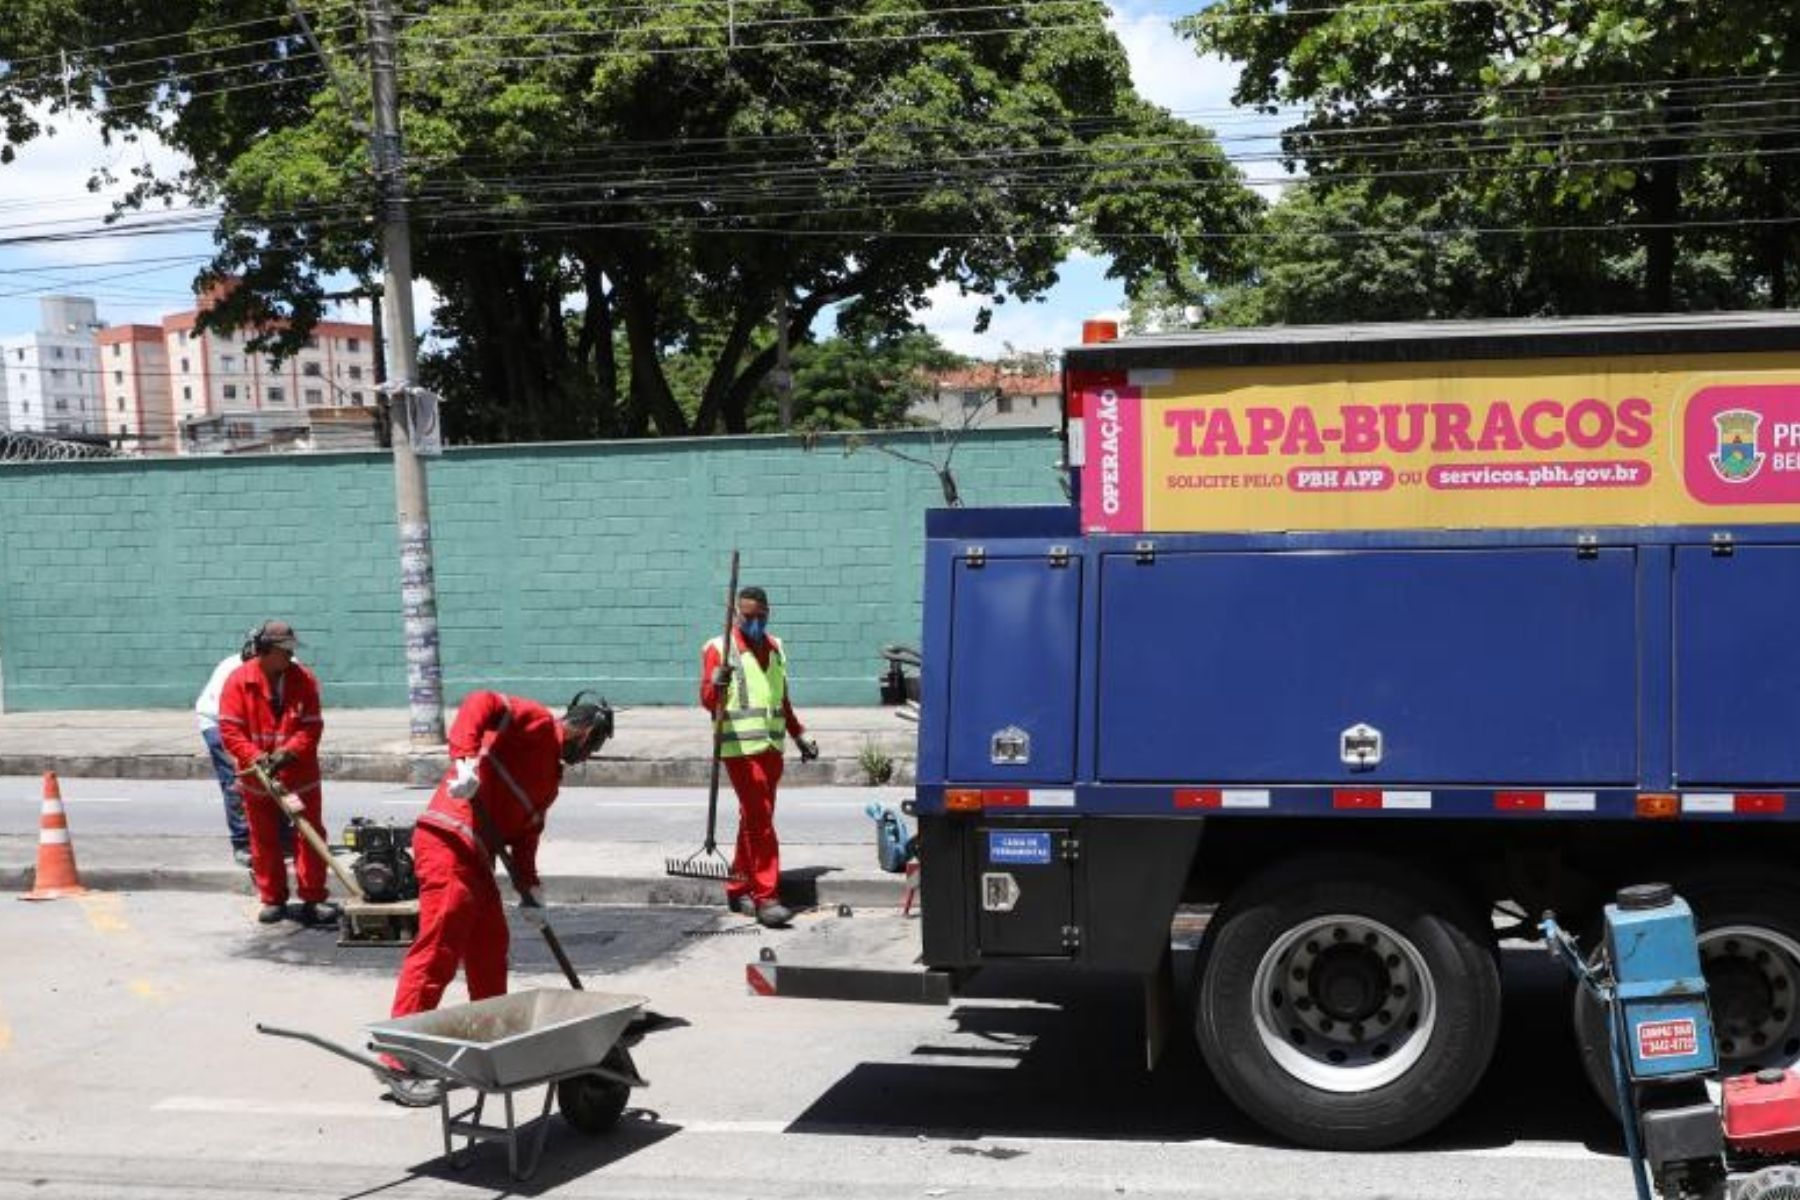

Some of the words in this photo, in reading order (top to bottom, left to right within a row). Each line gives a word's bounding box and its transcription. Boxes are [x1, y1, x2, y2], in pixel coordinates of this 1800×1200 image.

[1097, 389, 1122, 515] OPERAÇÃO
[1164, 397, 1653, 457] TAPA-BURACOS
[1167, 474, 1240, 489] SOLICITE
[1243, 473, 1283, 488] PELO
[1297, 470, 1339, 488] PBH
[1343, 469, 1384, 487] APP
[1398, 471, 1423, 485] OU
[1439, 463, 1640, 487] servicos.pbh.gov.br
